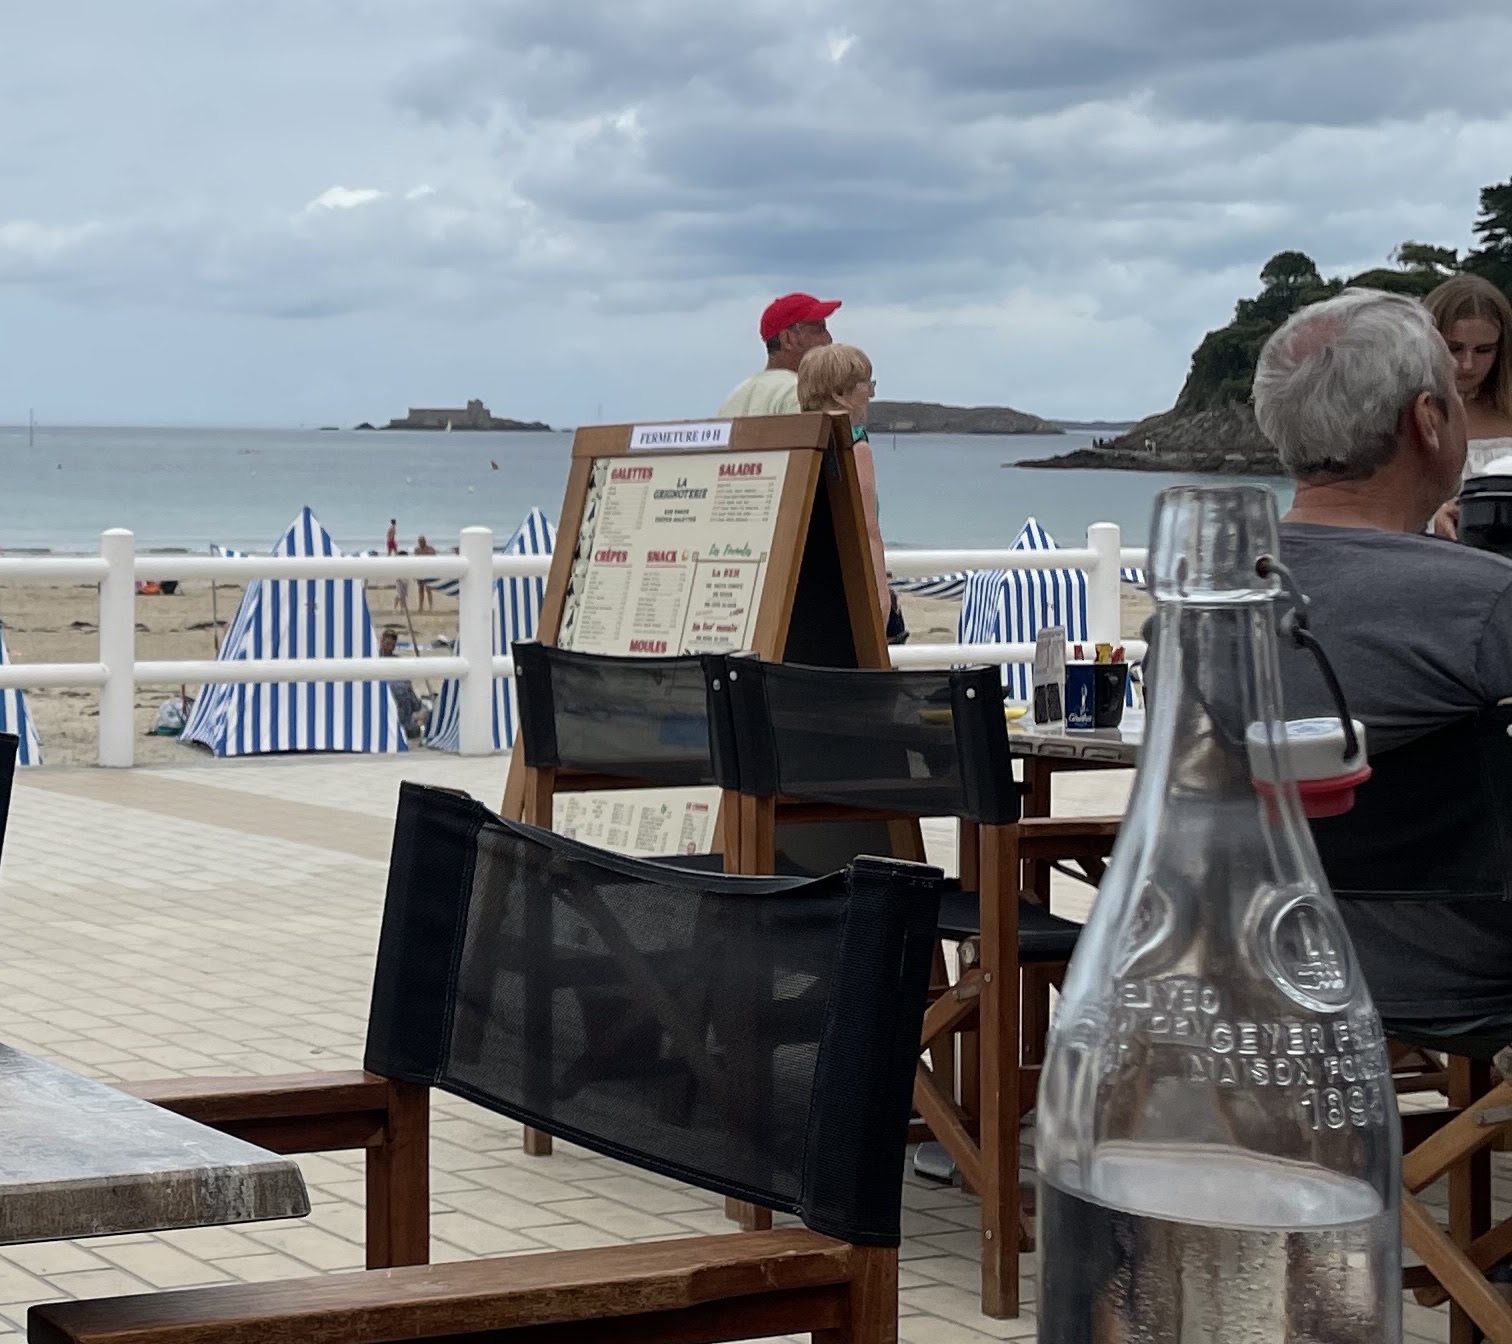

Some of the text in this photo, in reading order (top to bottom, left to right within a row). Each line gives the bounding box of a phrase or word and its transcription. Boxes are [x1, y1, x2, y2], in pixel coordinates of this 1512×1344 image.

[640, 430, 699, 444] FERMETURE
[713, 428, 721, 441] H
[611, 467, 653, 480] GALETTES
[719, 463, 762, 476] SALADES
[677, 478, 687, 488] LA
[647, 550, 677, 563] SNACK
[629, 638, 667, 654] MOULES
[1209, 1021, 1325, 1056] GEYER
